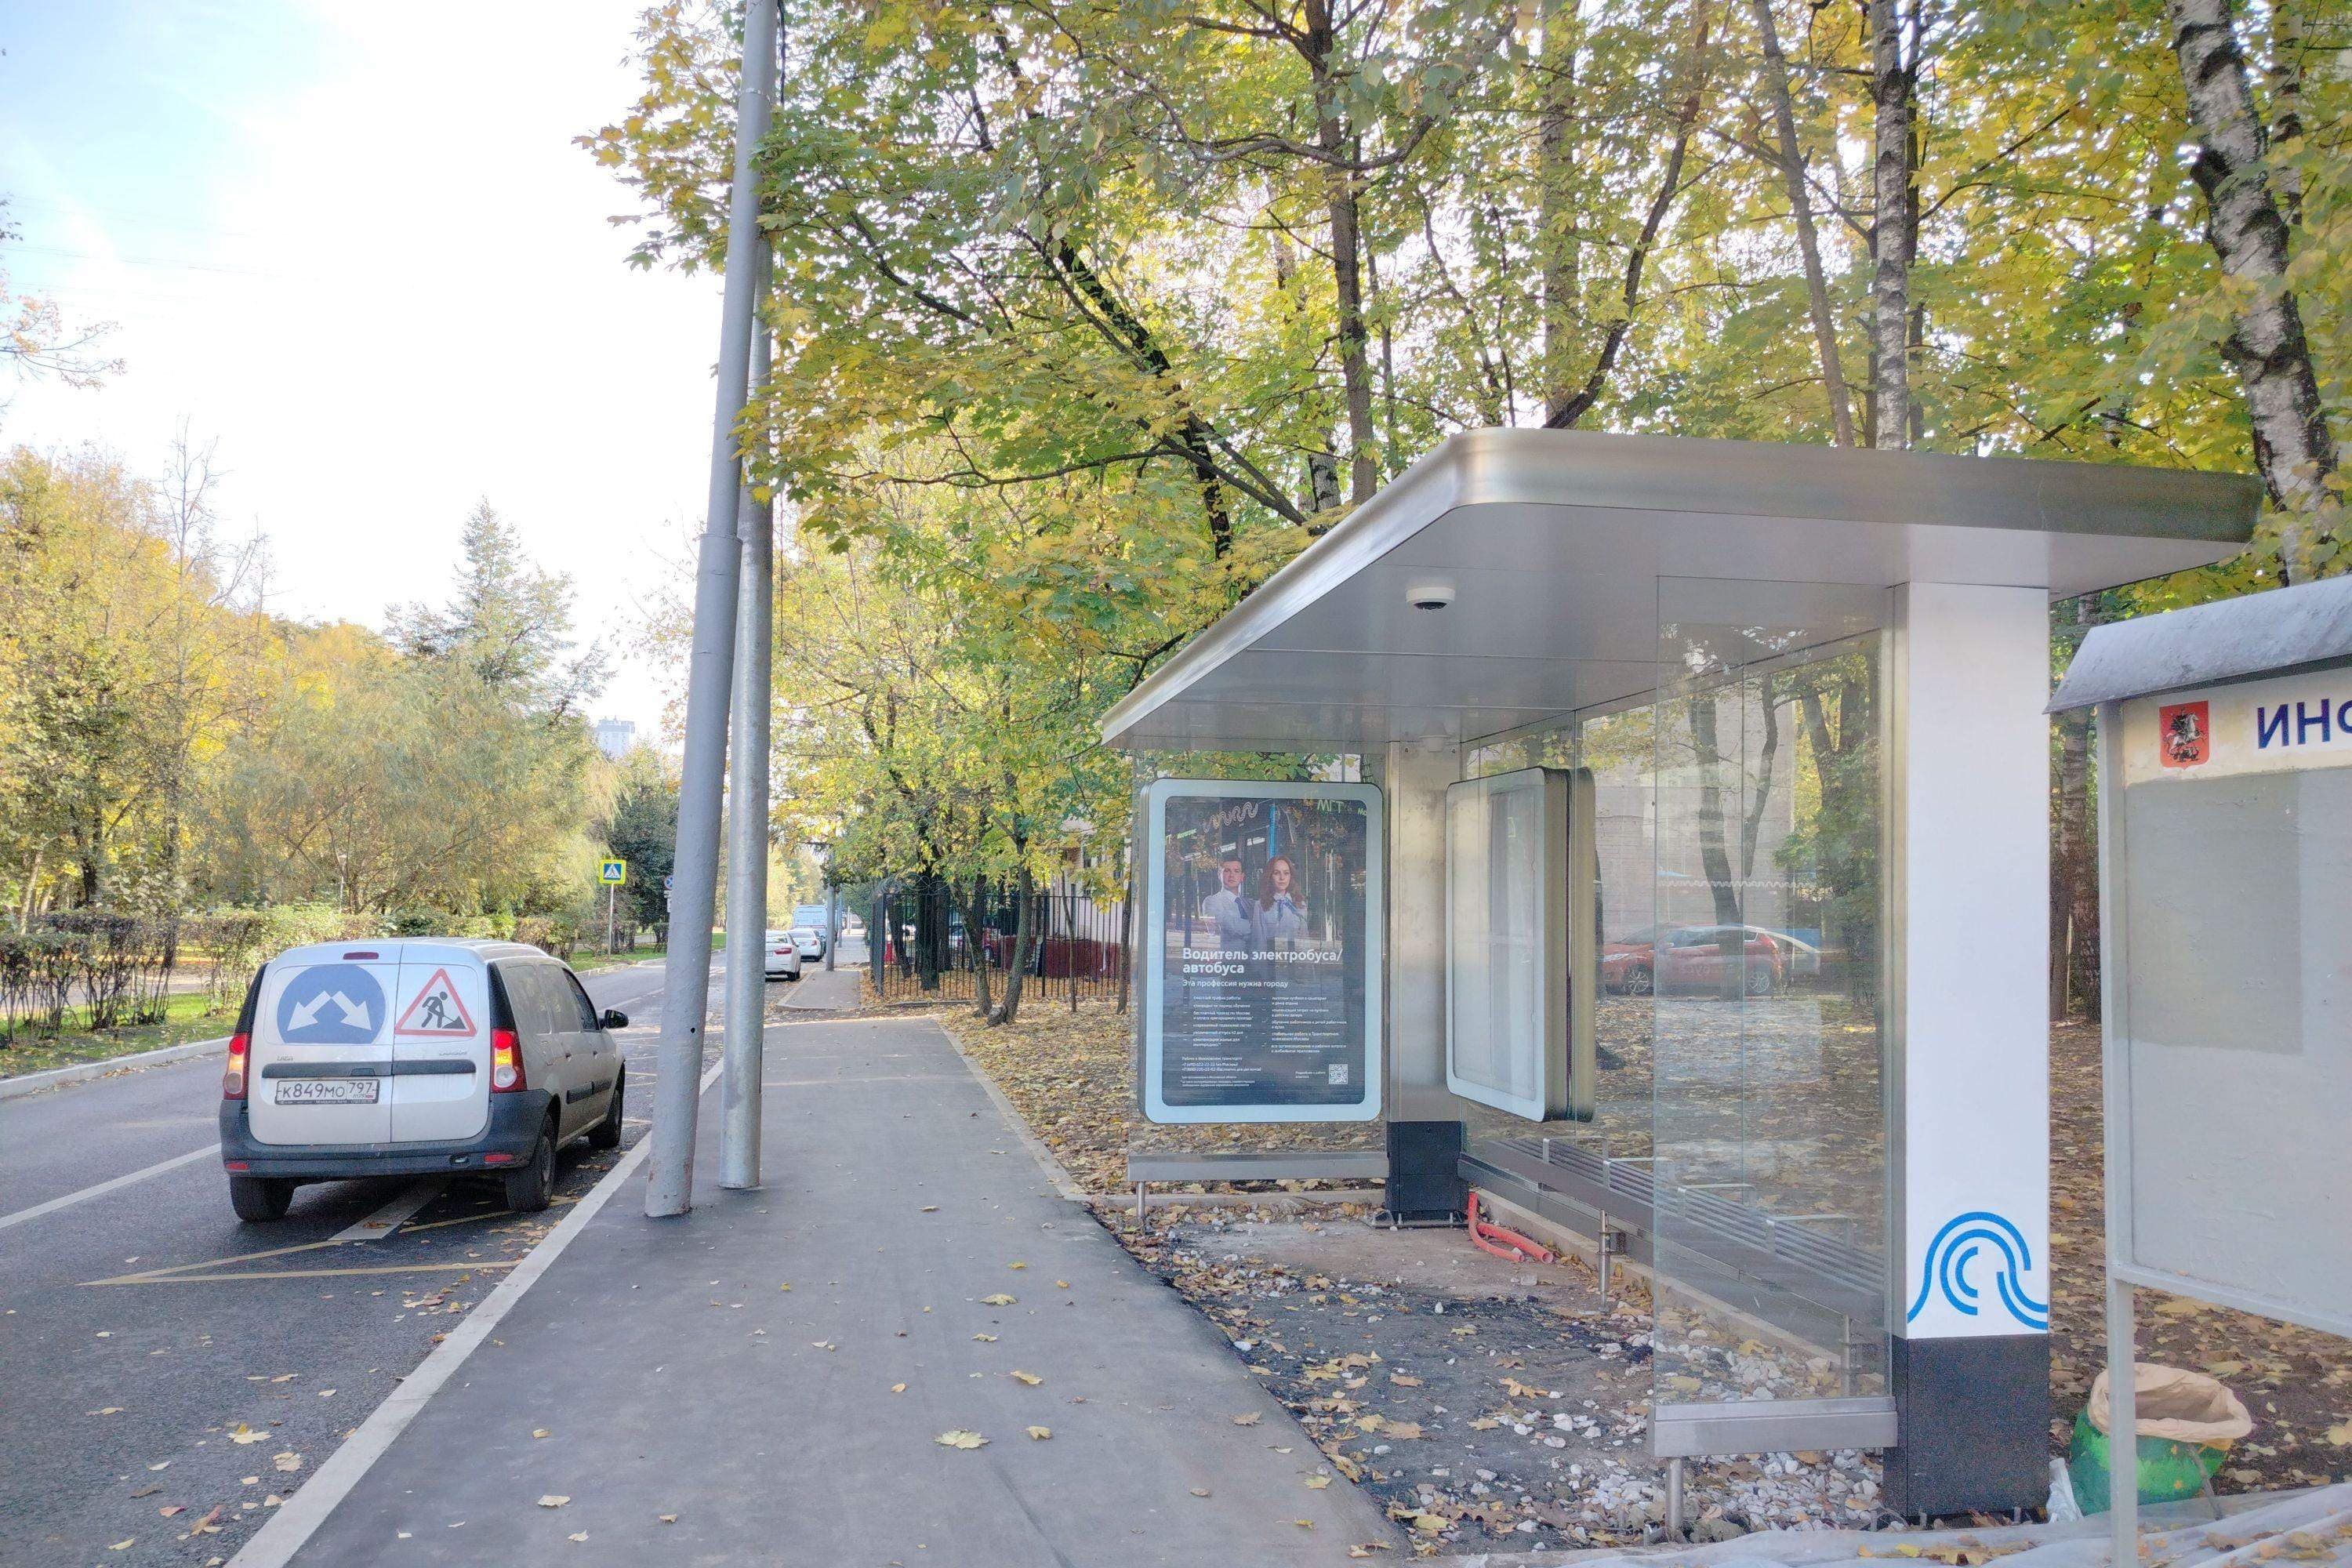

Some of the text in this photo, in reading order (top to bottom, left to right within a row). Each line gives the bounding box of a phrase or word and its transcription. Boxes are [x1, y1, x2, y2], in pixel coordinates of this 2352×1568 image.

[1182, 947, 1343, 964] Водитель электробуса/
[1182, 961, 1245, 976] автобуса
[1197, 979, 1237, 988] профессия
[349, 1082, 372, 1094] 797
